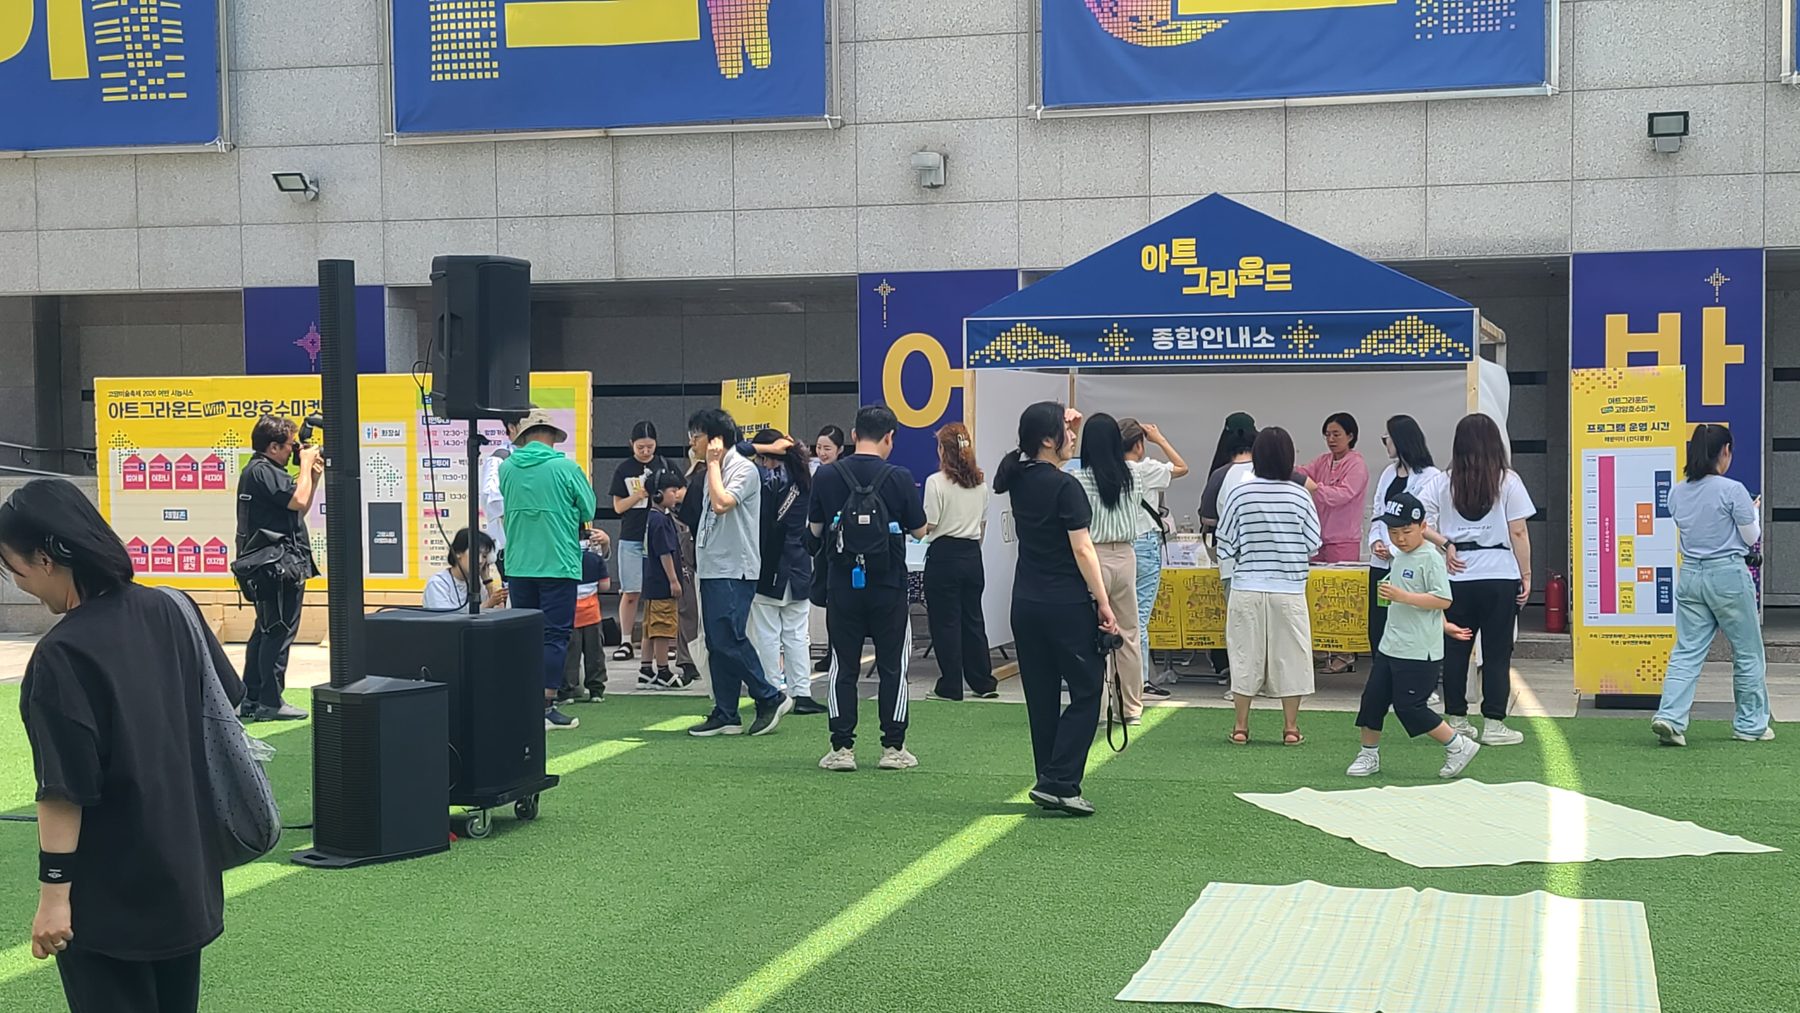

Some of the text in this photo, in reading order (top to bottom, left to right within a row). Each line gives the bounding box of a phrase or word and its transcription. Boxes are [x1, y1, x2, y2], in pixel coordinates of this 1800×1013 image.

[1141, 238, 1198, 273] 아트
[1182, 256, 1293, 299] 그라운드
[1151, 326, 1276, 351] 종합안내소
[108, 400, 202, 419] 아트그라운드
[381, 429, 401, 437] 화장실
[1586, 421, 1670, 433] 프로그램 운영 시간
